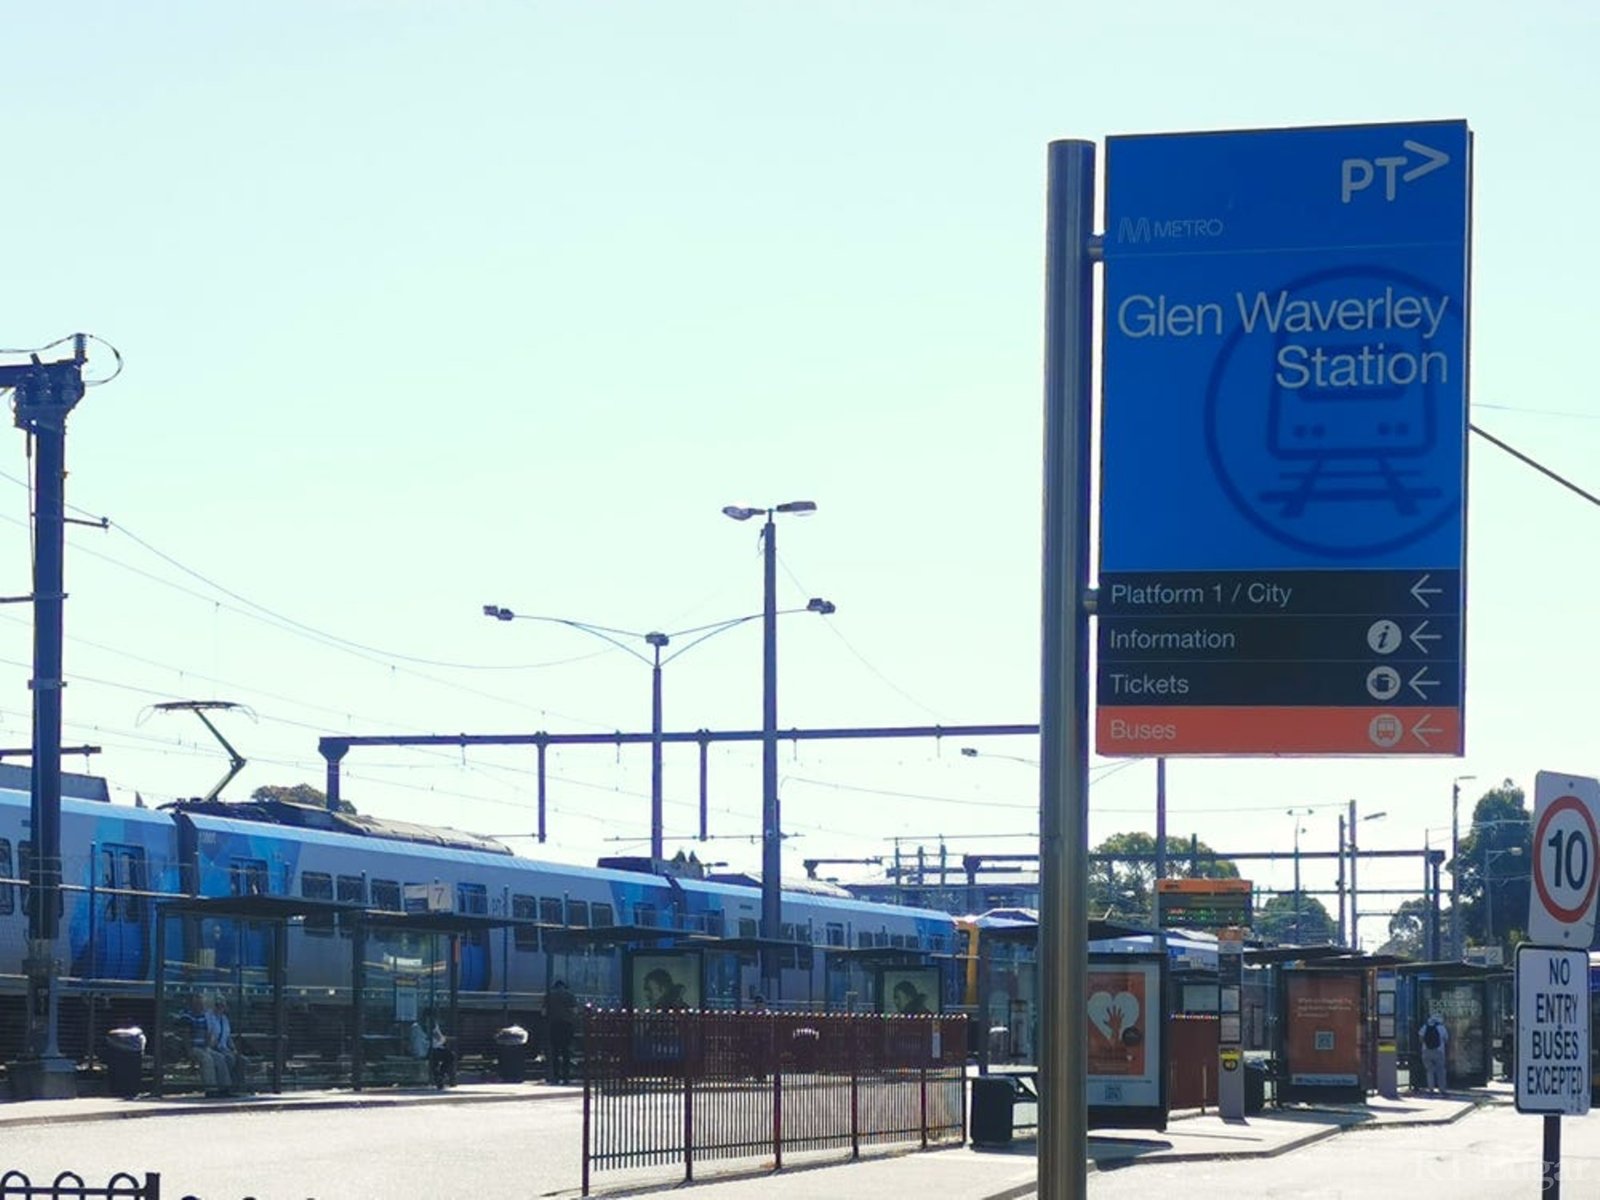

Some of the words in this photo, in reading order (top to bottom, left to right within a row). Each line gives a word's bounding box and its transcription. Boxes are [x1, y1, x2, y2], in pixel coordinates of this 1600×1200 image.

[1153, 218, 1223, 238] METRO
[1118, 294, 1222, 338] Glen
[1236, 287, 1449, 338] Waverley
[1276, 343, 1448, 388] Station
[1110, 584, 1204, 605] Platform
[1212, 584, 1223, 603] 1
[1248, 583, 1292, 609] City
[1110, 628, 1236, 649] Information
[1109, 673, 1190, 695] Tickets
[1110, 720, 1177, 740] Buses
[1548, 829, 1588, 891] 10
[434, 887, 445, 906] 7
[1549, 957, 1571, 986] NO
[1536, 993, 1578, 1024] ENTRY
[1532, 1031, 1579, 1060] BUSES
[1527, 1066, 1583, 1096] EXCEPTED
